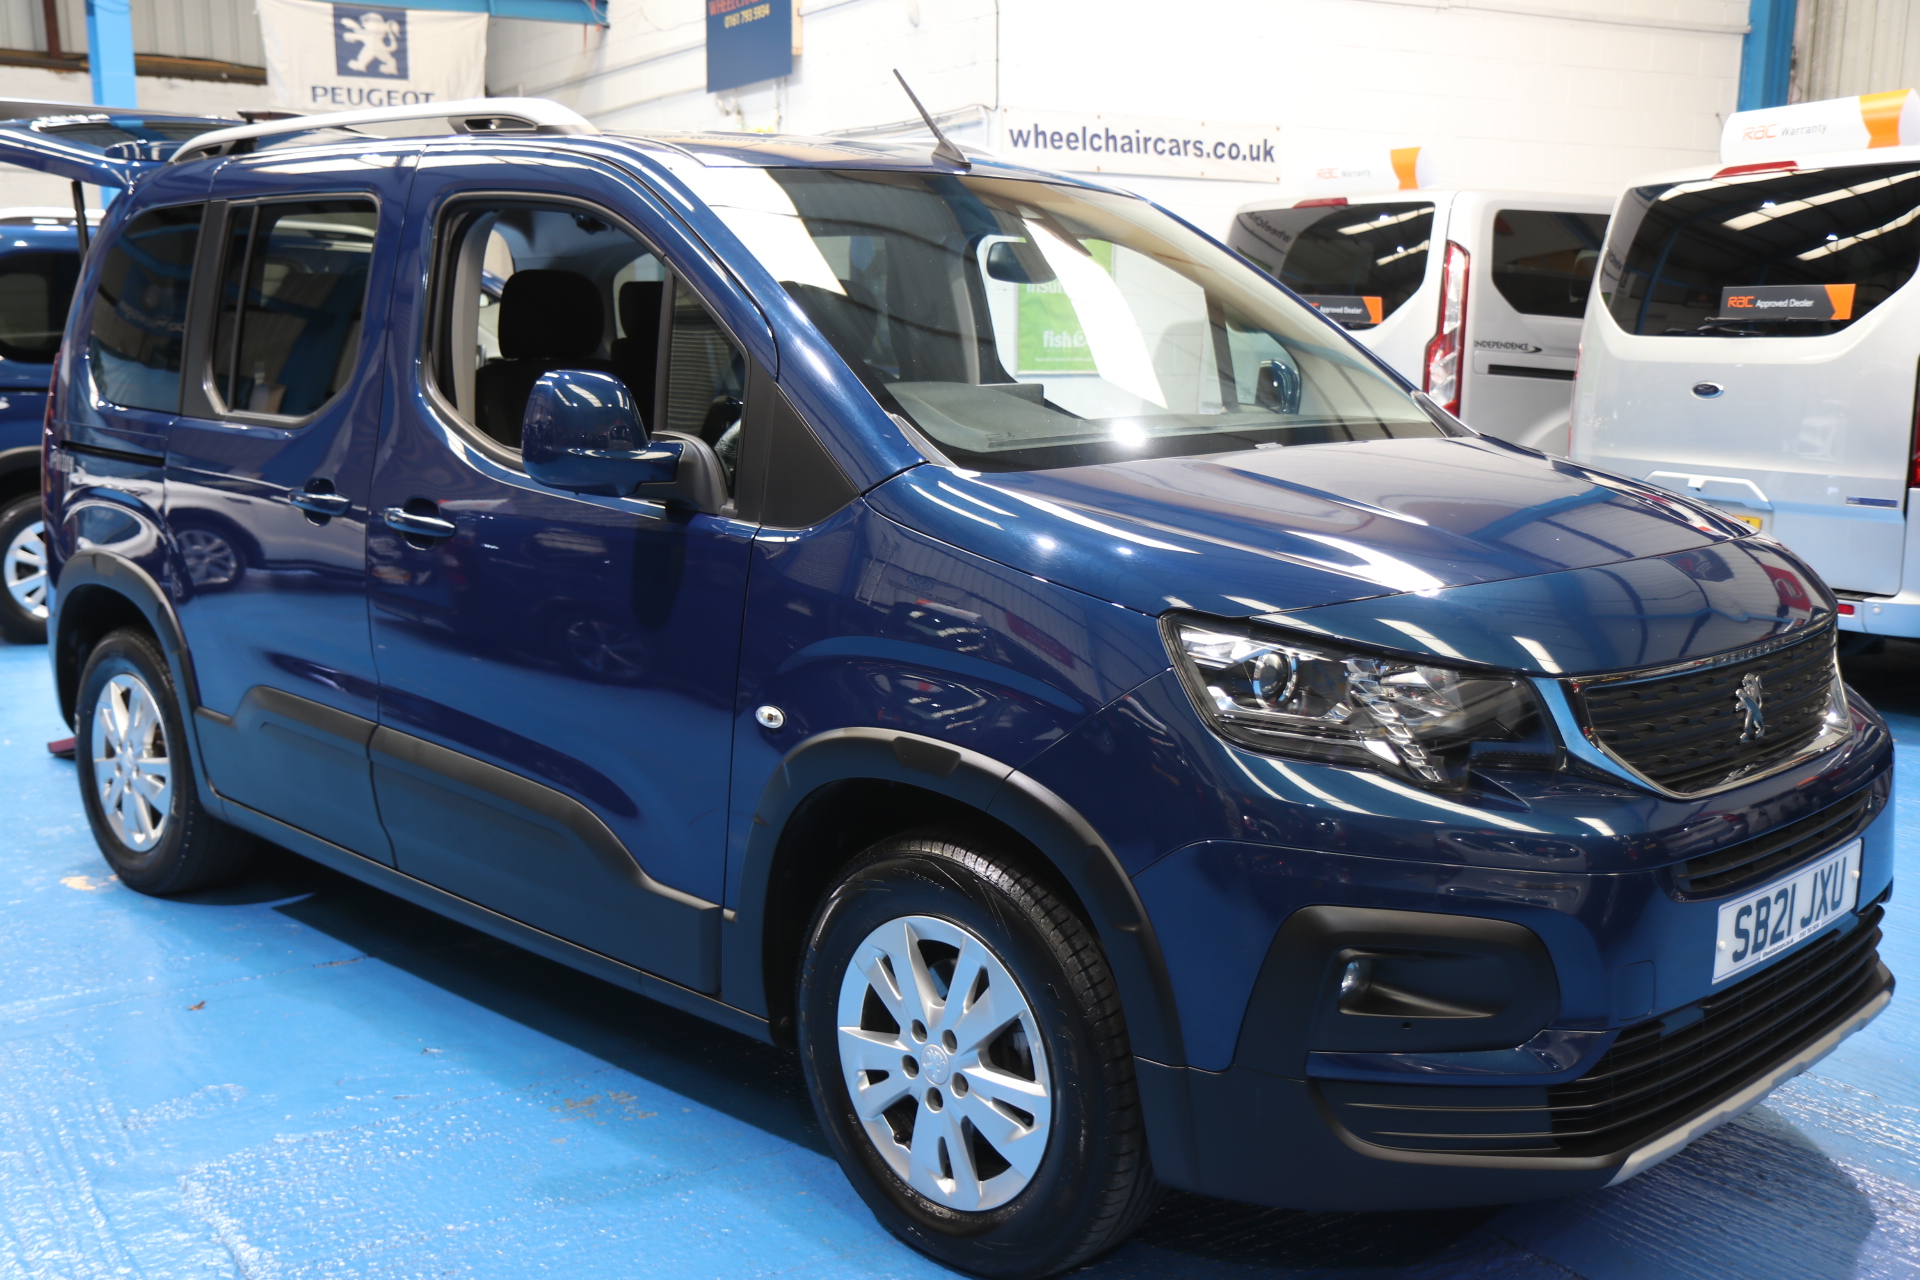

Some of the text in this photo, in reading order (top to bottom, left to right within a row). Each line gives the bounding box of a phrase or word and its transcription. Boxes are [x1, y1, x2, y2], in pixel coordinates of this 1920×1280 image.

[311, 86, 435, 107] PEUGEOT
[1781, 123, 1828, 136] Warranty
[1008, 123, 1275, 163] wheelchaircars.co.uk
[1755, 299, 1788, 309] Approved
[1789, 299, 1814, 307] Dealer
[1042, 330, 1072, 348] fish
[1473, 340, 1529, 351] INDEPENDENCE
[1732, 856, 1848, 963] SB21 JXU
